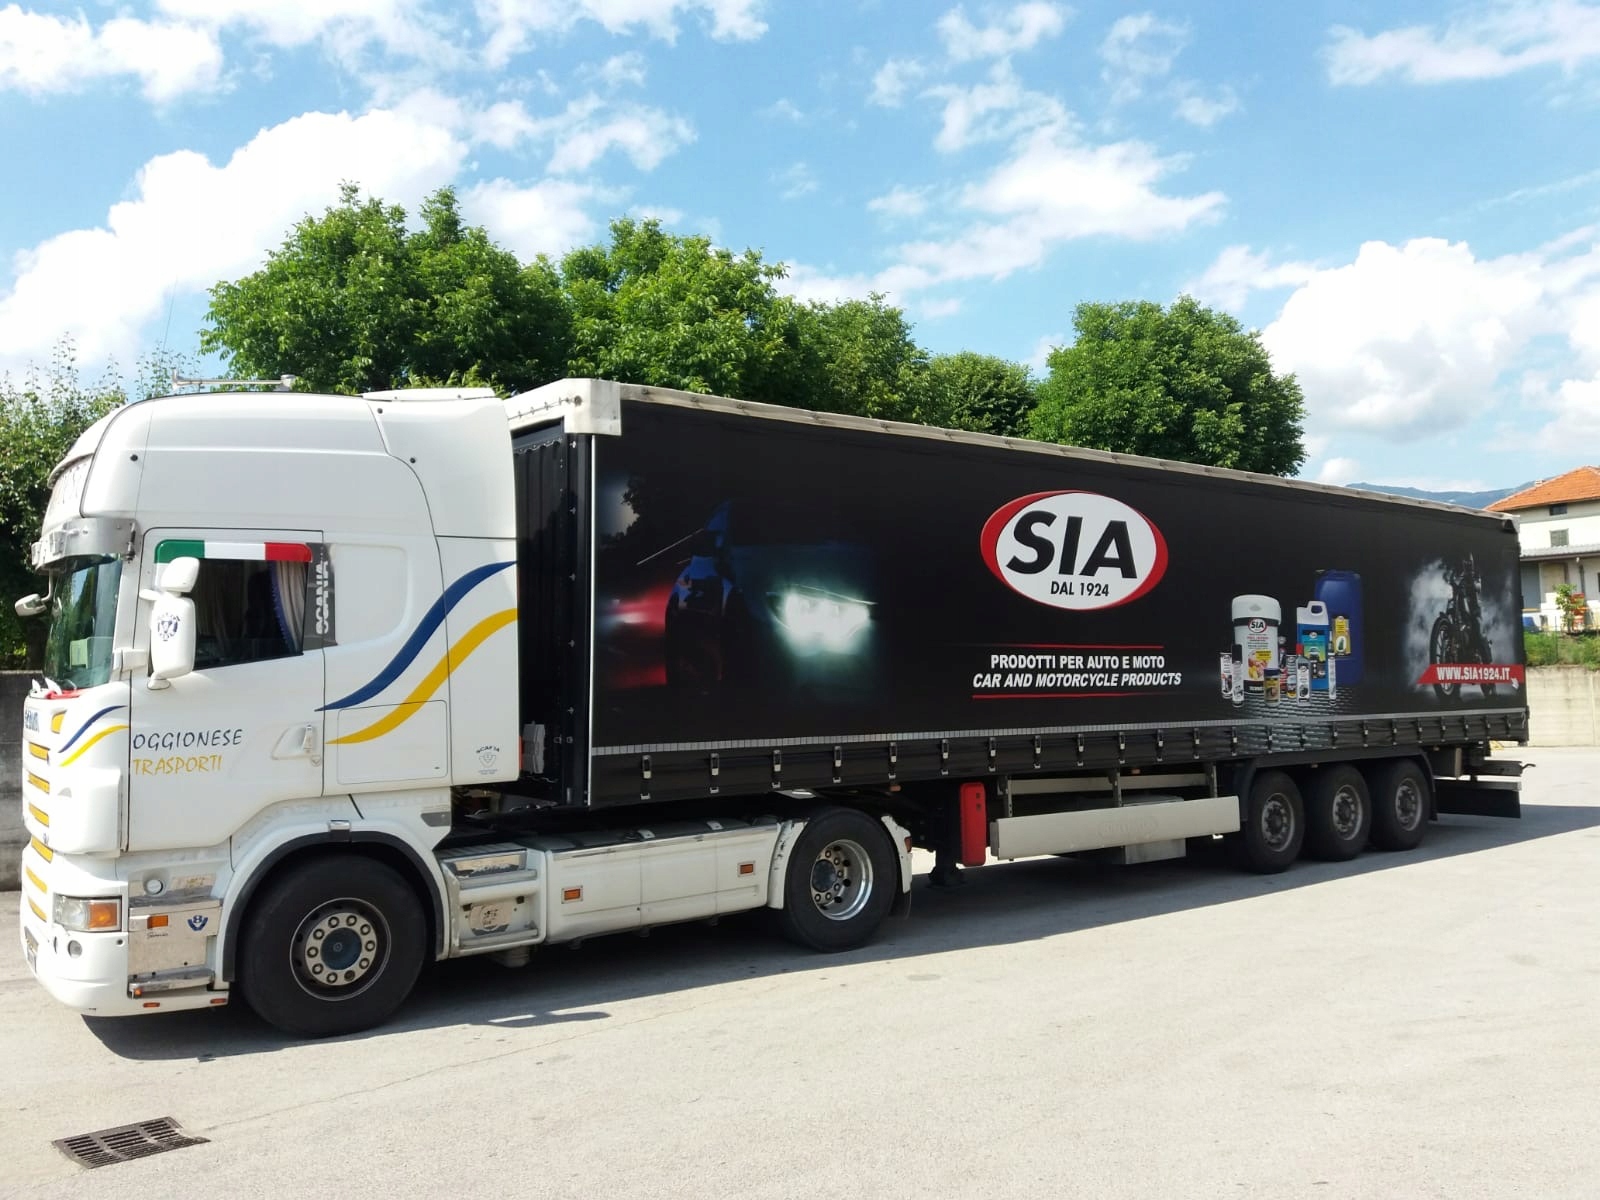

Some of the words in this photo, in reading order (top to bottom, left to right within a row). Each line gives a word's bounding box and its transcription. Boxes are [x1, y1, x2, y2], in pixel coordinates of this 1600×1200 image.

[1006, 510, 1138, 579] SIA
[315, 560, 329, 635] SCANIA
[1050, 580, 1075, 596] DAL
[1079, 582, 1109, 597] 1924
[991, 654, 1056, 669] PRODOTTI
[1060, 654, 1084, 669] PER
[1087, 654, 1120, 669] AUTO
[1122, 655, 1130, 669] E
[1133, 654, 1165, 669] MOTO
[973, 673, 1001, 688] CAR
[1004, 673, 1033, 688] AND
[1035, 672, 1119, 688] MOTORCYCLE
[1121, 672, 1182, 686] PRODUCTS
[1437, 667, 1510, 681] WWW.SIA1924.IT
[133, 729, 243, 751] OGGIONESE
[133, 754, 223, 775] TRASPORTI
